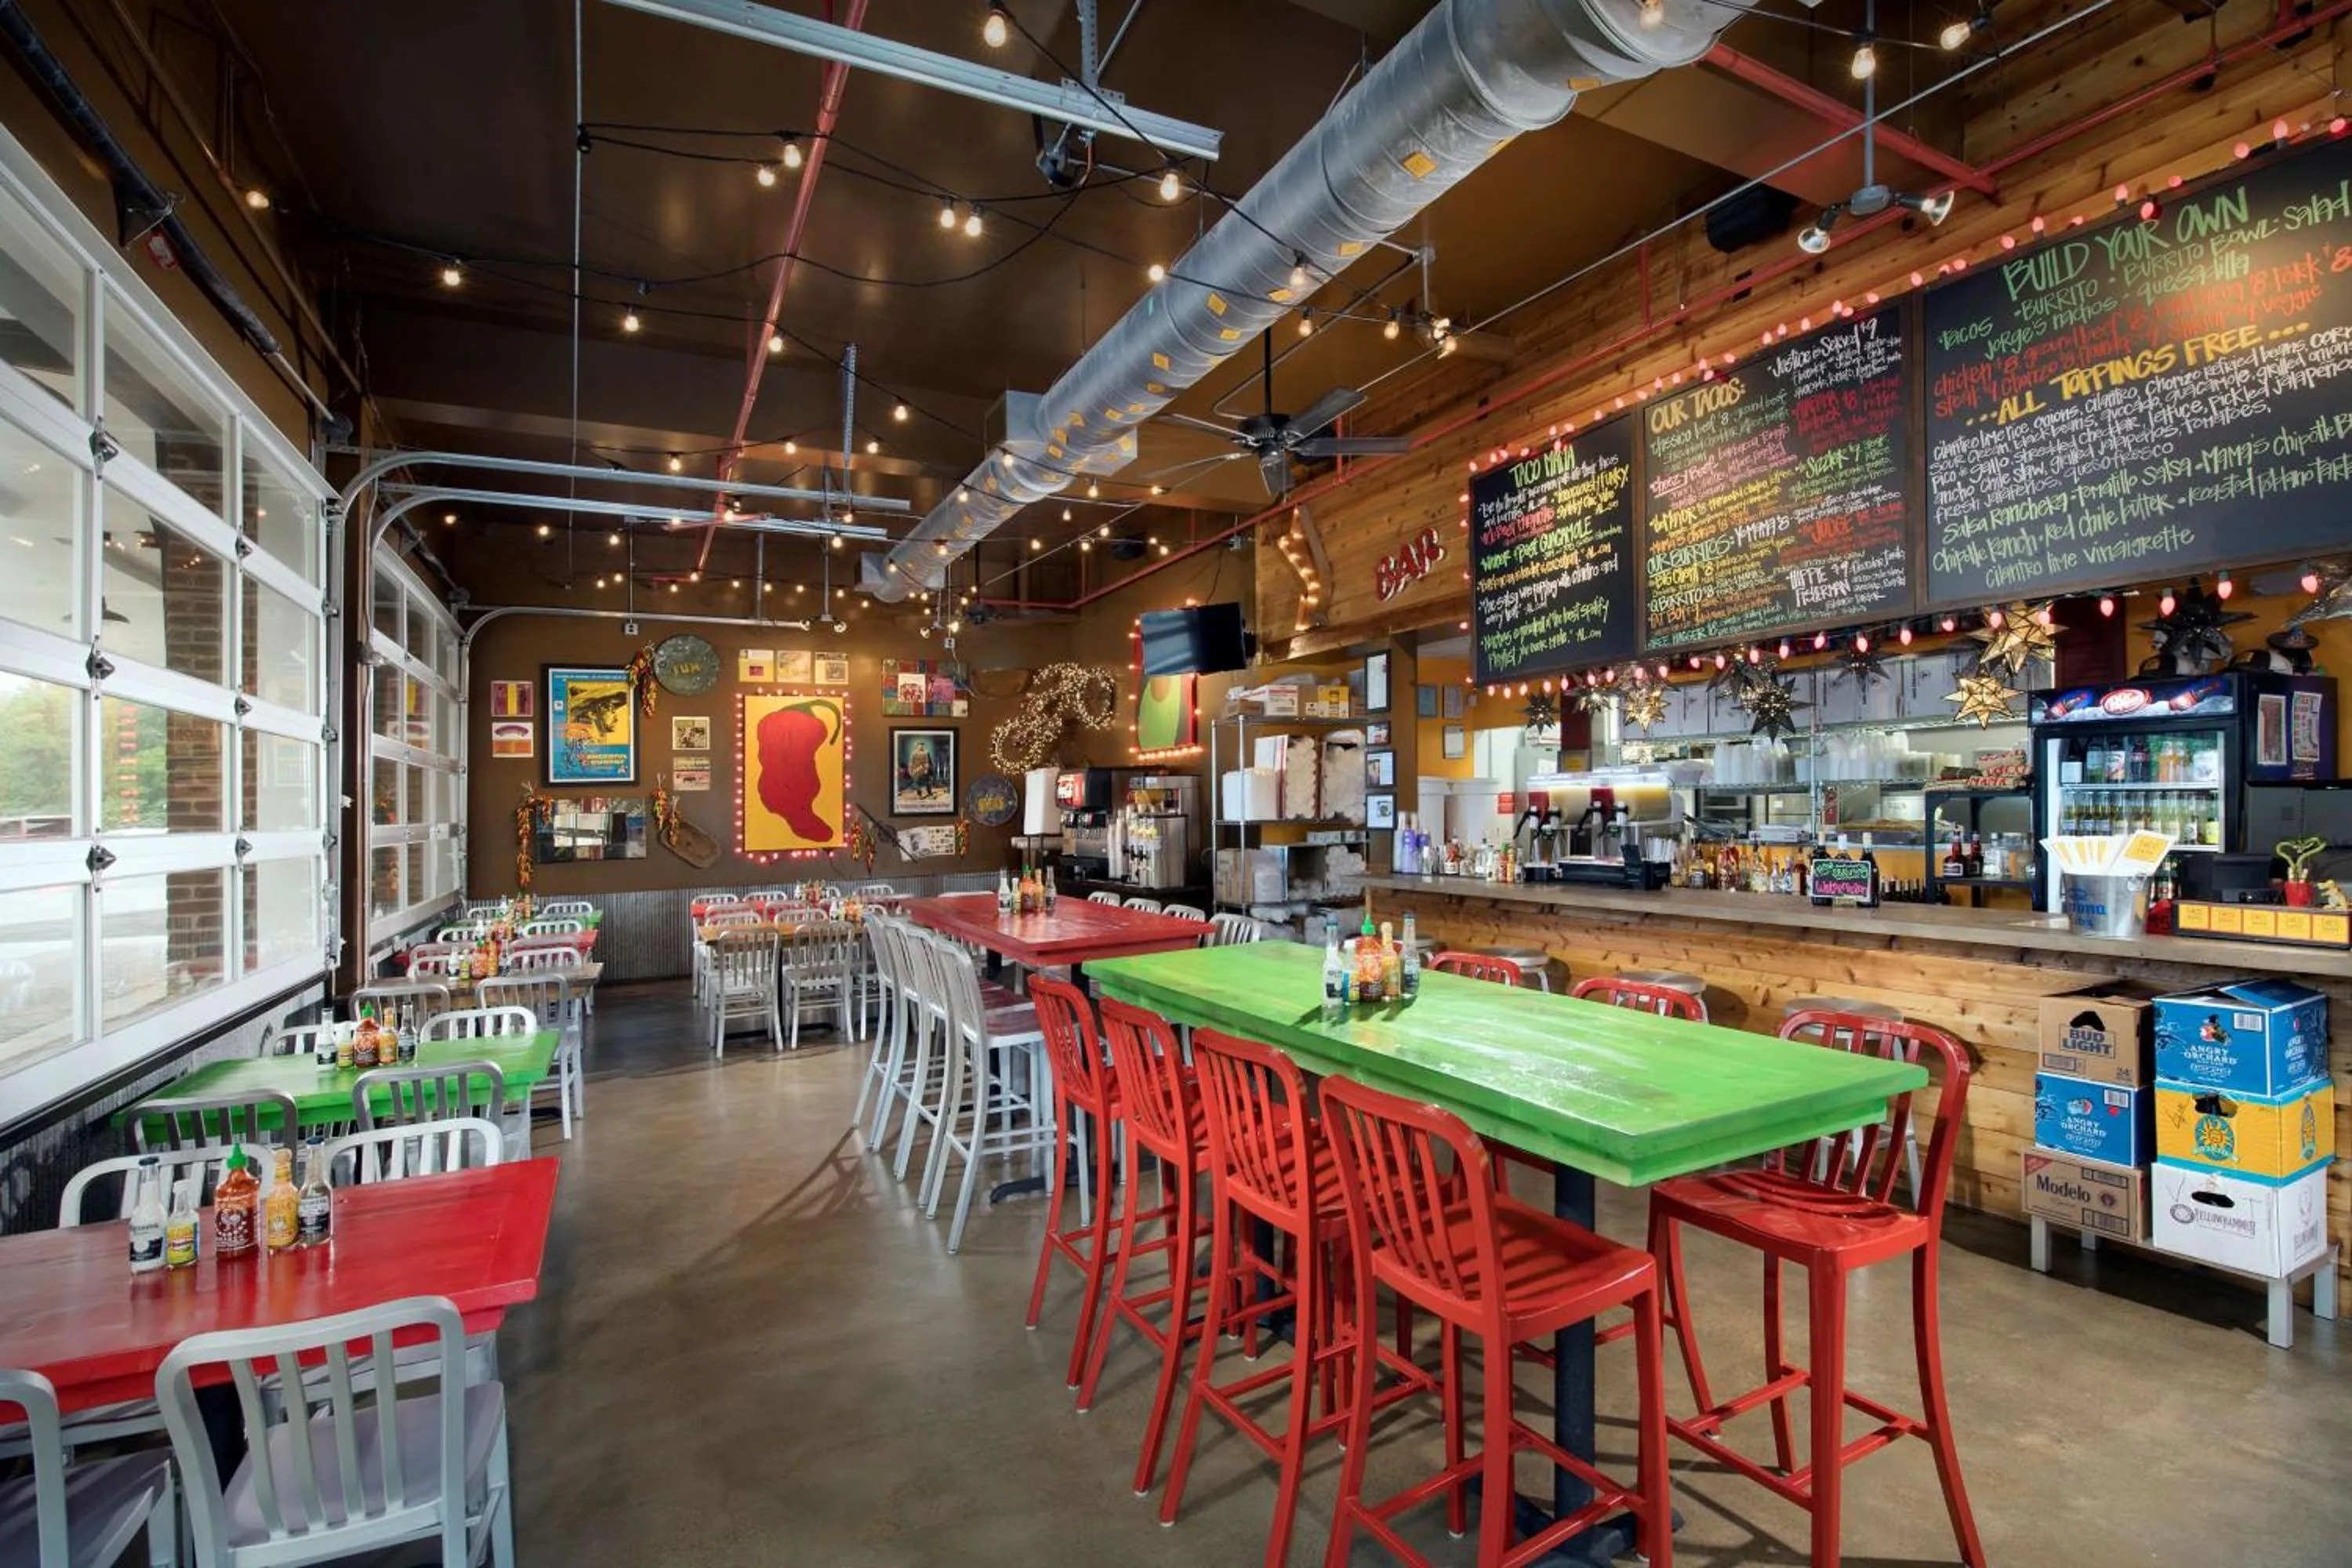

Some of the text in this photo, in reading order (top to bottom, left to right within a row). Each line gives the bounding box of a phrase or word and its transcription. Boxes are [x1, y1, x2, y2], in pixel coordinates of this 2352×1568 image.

[2003, 241, 2090, 301] BUILD
[2095, 220, 2170, 270] YOUR
[2176, 186, 2249, 242] OWN
[2049, 343, 2176, 401] TOPPINGS
[1650, 397, 1690, 434] OUR
[1509, 458, 1541, 488] TACO
[1375, 526, 1444, 603] BAR
[2062, 1038, 2113, 1055] LIGHT
[2070, 1028, 2105, 1044] BUD
[2183, 1051, 2239, 1066] ORCHARD
[2190, 1044, 2230, 1057] ANGRY
[2061, 1122, 2107, 1138] ORCHARD
[2067, 1116, 2101, 1129] ANGRY
[2035, 1174, 2091, 1203] Modelo
